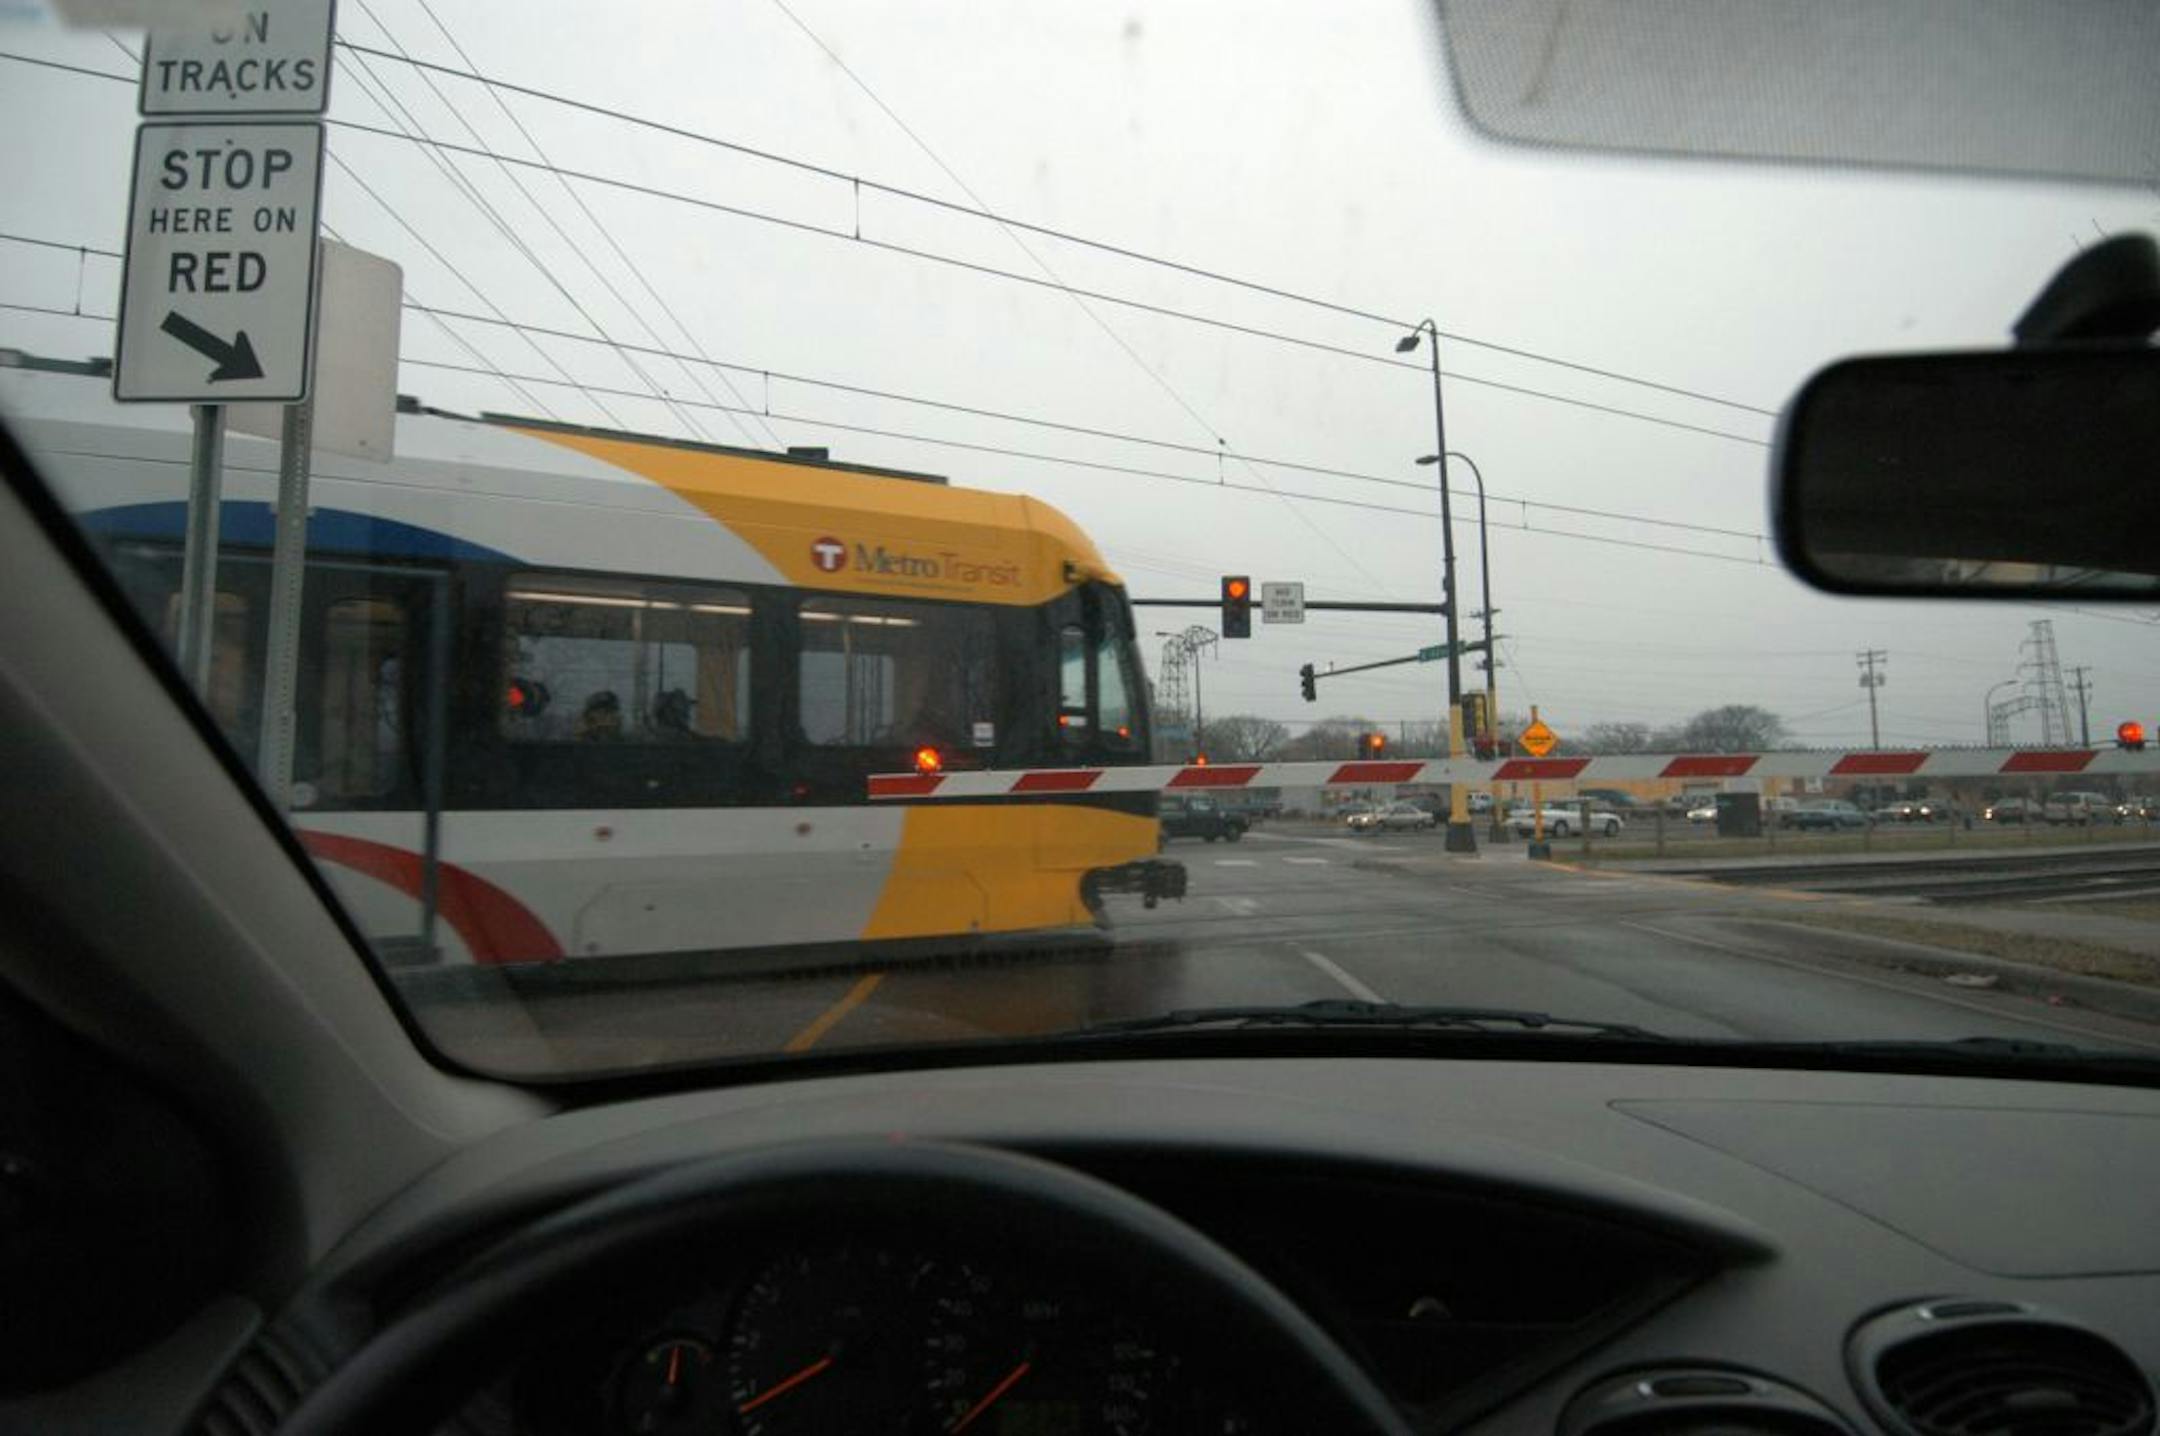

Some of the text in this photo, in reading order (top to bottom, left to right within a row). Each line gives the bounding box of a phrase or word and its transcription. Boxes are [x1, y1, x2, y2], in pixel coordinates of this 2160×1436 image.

[157, 59, 316, 93] TRACKS
[160, 148, 293, 191] STOP
[149, 207, 296, 235] HERE ON
[168, 251, 267, 294] RED
